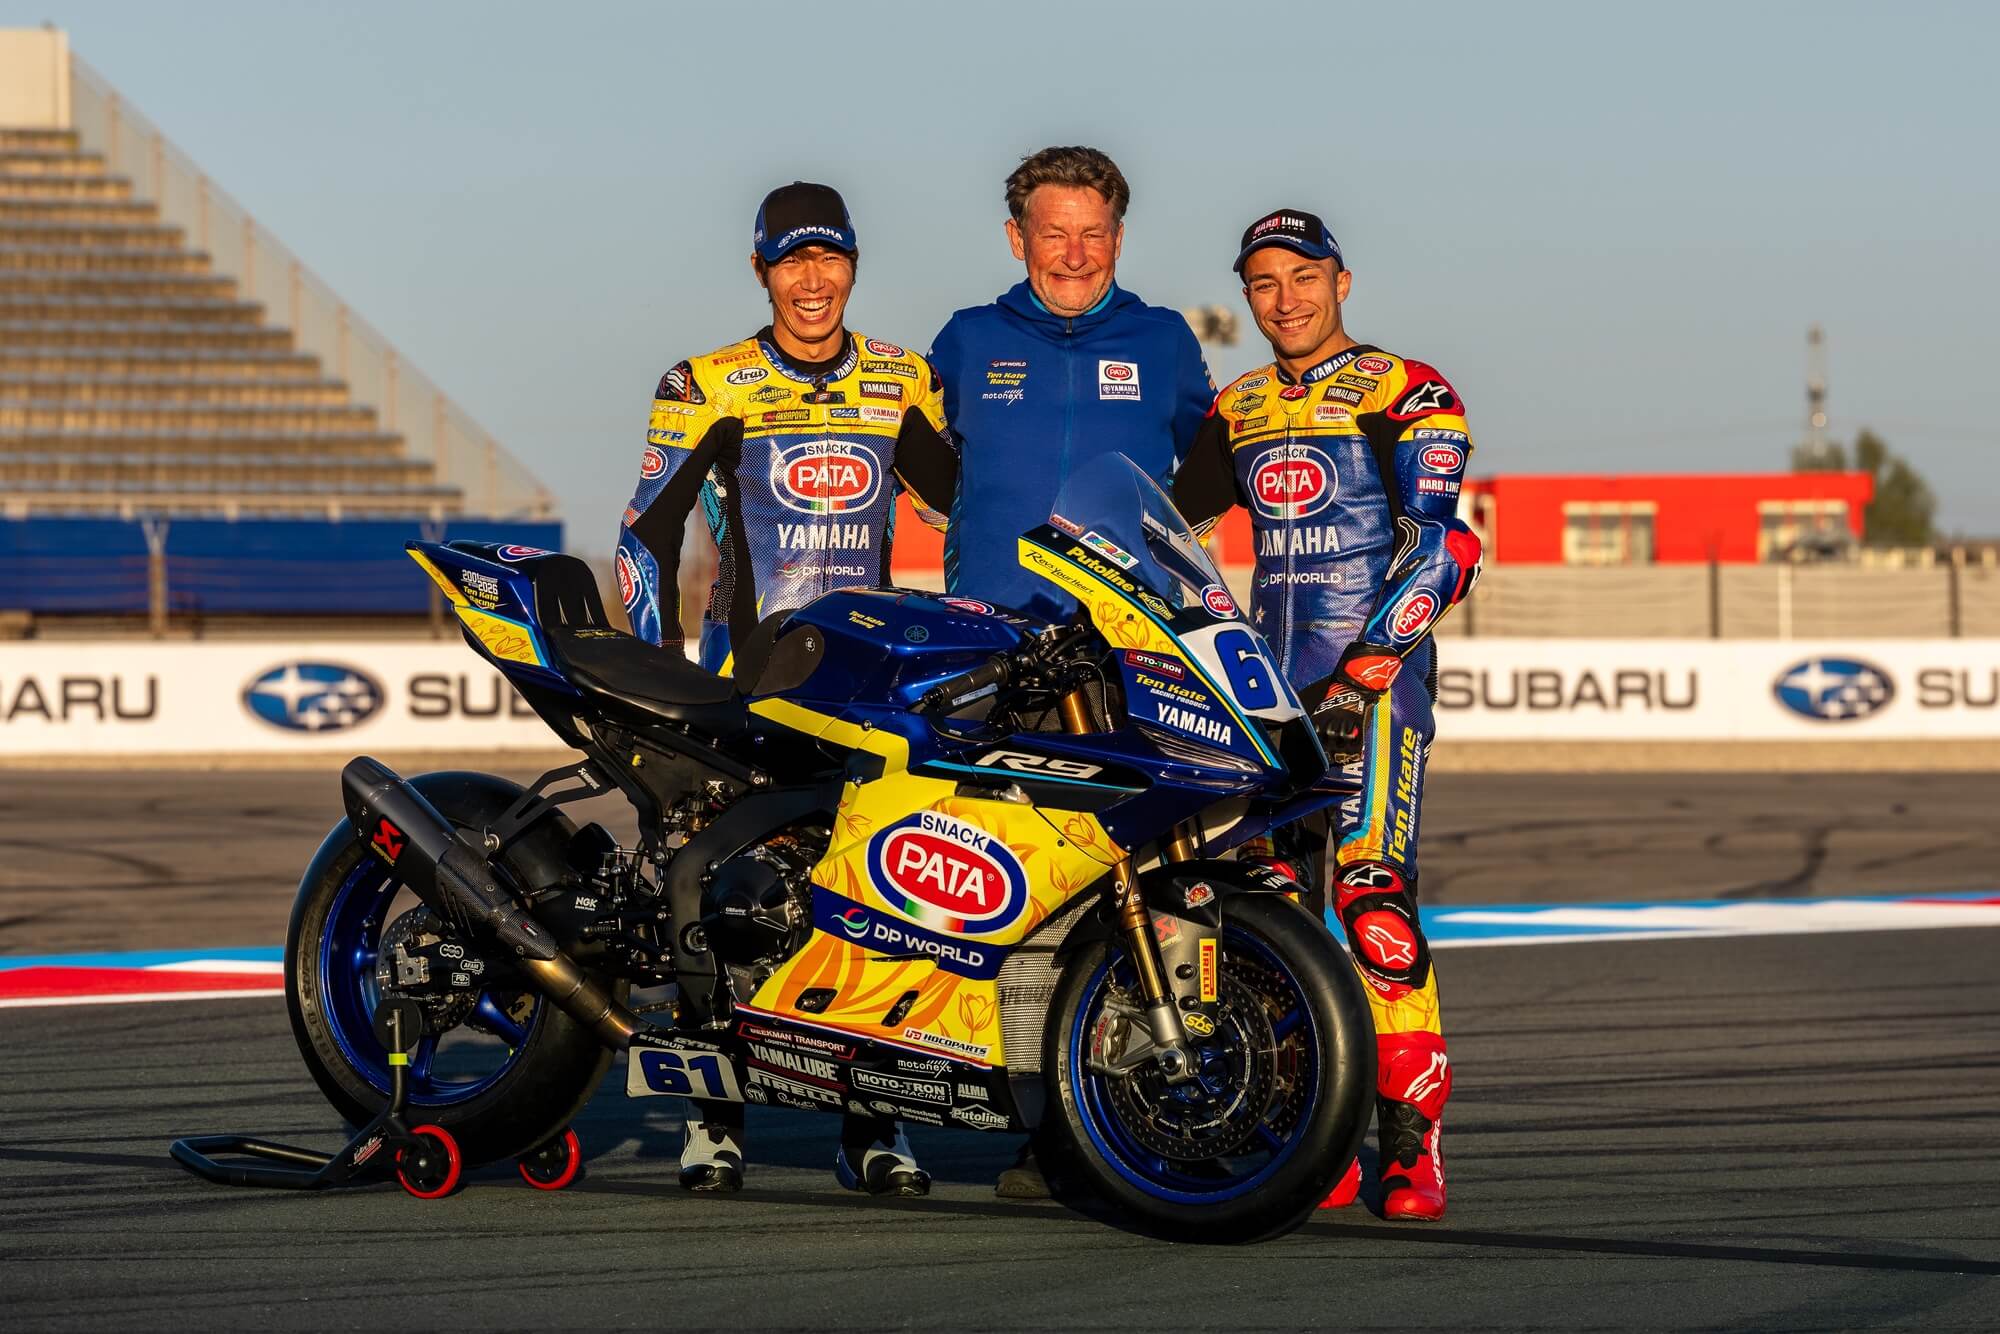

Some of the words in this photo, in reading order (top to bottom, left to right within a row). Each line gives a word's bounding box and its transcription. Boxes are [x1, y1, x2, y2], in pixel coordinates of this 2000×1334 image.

[1281, 216, 1306, 228] LINE
[789, 226, 843, 241] YAMAHA
[733, 367, 764, 382] Arai
[833, 351, 859, 380] YAMAHA
[1109, 368, 1129, 376] PATA
[1310, 352, 1357, 381] YAMAHA
[1360, 360, 1385, 370] PATA
[749, 388, 791, 403] Putoline
[861, 382, 902, 395] YAMALUBE
[1110, 384, 1137, 392] YAMAHA
[1327, 386, 1362, 404] YAMALUBE
[871, 408, 900, 419] YAMAHA
[1415, 430, 1467, 441] GYTR
[807, 443, 849, 456] SNACK
[1271, 447, 1307, 461] SNACK
[1428, 453, 1455, 465] PATA
[797, 464, 860, 489] PATA
[1262, 469, 1314, 495] PATA
[1419, 479, 1443, 491] HARD
[777, 523, 870, 550] YAMAHA
[802, 566, 821, 577] DP
[824, 566, 865, 577] WORLD
[1024, 549, 1055, 571] Revs
[1070, 577, 1095, 595] Heart
[1066, 545, 1136, 594] Putoline
[1285, 571, 1342, 585] WORLD
[463, 585, 478, 596] Ten
[480, 591, 499, 602] Kate
[478, 580, 499, 595] 2026
[1209, 594, 1233, 609] PATA
[1392, 593, 1415, 616] SNACK
[1399, 600, 1430, 632] PATA
[1129, 652, 1182, 675] MOTO-TRON
[0, 676, 158, 722] ARU
[1136, 673, 1166, 690] Ten
[1168, 683, 1207, 703] Kate
[1437, 670, 1698, 710] SUBARU
[1150, 687, 1176, 700] RACING
[1176, 695, 1211, 712] PRODUCTS
[1157, 702, 1232, 746] YAMAHA
[975, 750, 1103, 779] R9
[1396, 726, 1416, 804] Kate
[922, 814, 987, 851] SNACK
[1388, 808, 1409, 865] Ten
[896, 840, 987, 907] PATA
[575, 896, 598, 908] NGK
[873, 923, 901, 944] DP
[904, 933, 985, 968] WORLD
[1202, 944, 1214, 996] PIRELLI
[1184, 1013, 1214, 1034] sbs
[793, 1034, 846, 1052] TRANSPORT
[923, 1033, 987, 1056] HOCOPARTS
[747, 1041, 839, 1081] YAMALUBE
[897, 1059, 953, 1076] motonext
[639, 1050, 729, 1098] 61
[857, 1071, 946, 1096] MOTO-TRON
[746, 1066, 843, 1106] PIRELLI
[900, 1089, 946, 1101] RACING
[957, 1082, 989, 1098] ALMA
[951, 1107, 1010, 1124] Putoline
